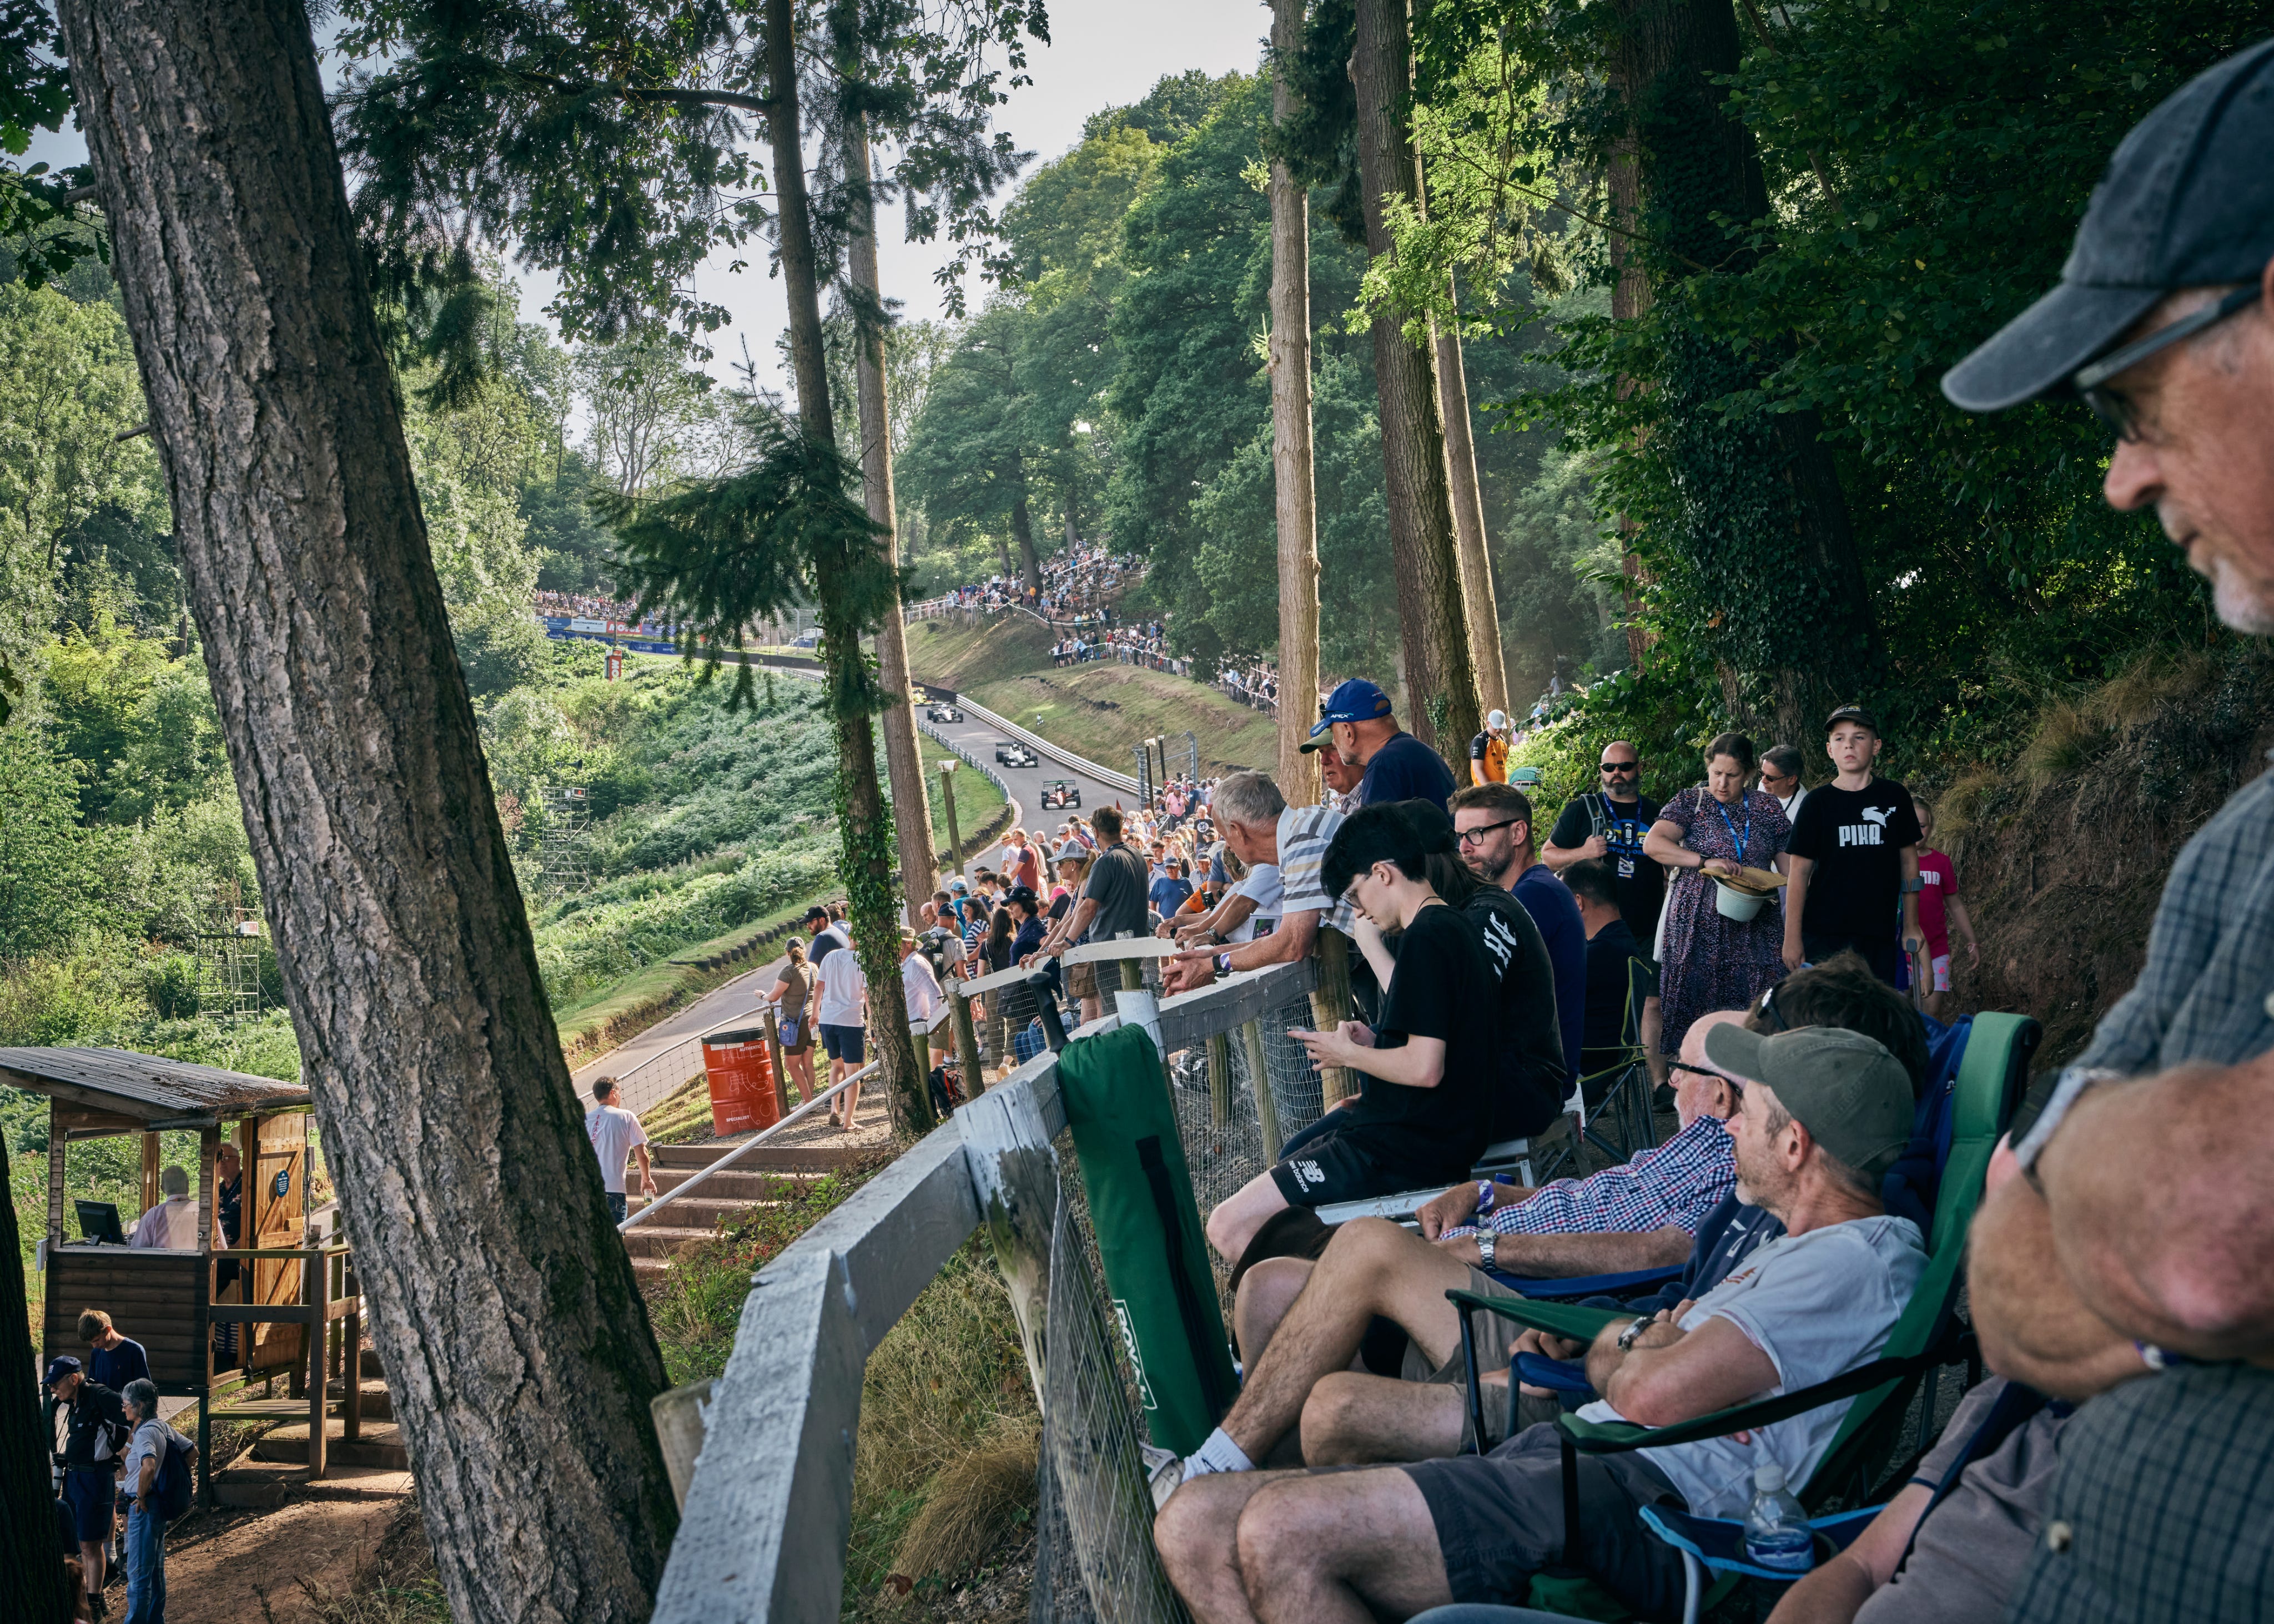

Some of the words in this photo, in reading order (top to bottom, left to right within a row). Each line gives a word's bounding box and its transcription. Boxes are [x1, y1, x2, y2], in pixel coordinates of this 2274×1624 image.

[1839, 824, 1880, 846] PIKA
[1919, 870, 1940, 885] MA
[1293, 1168, 1309, 1193] balance
